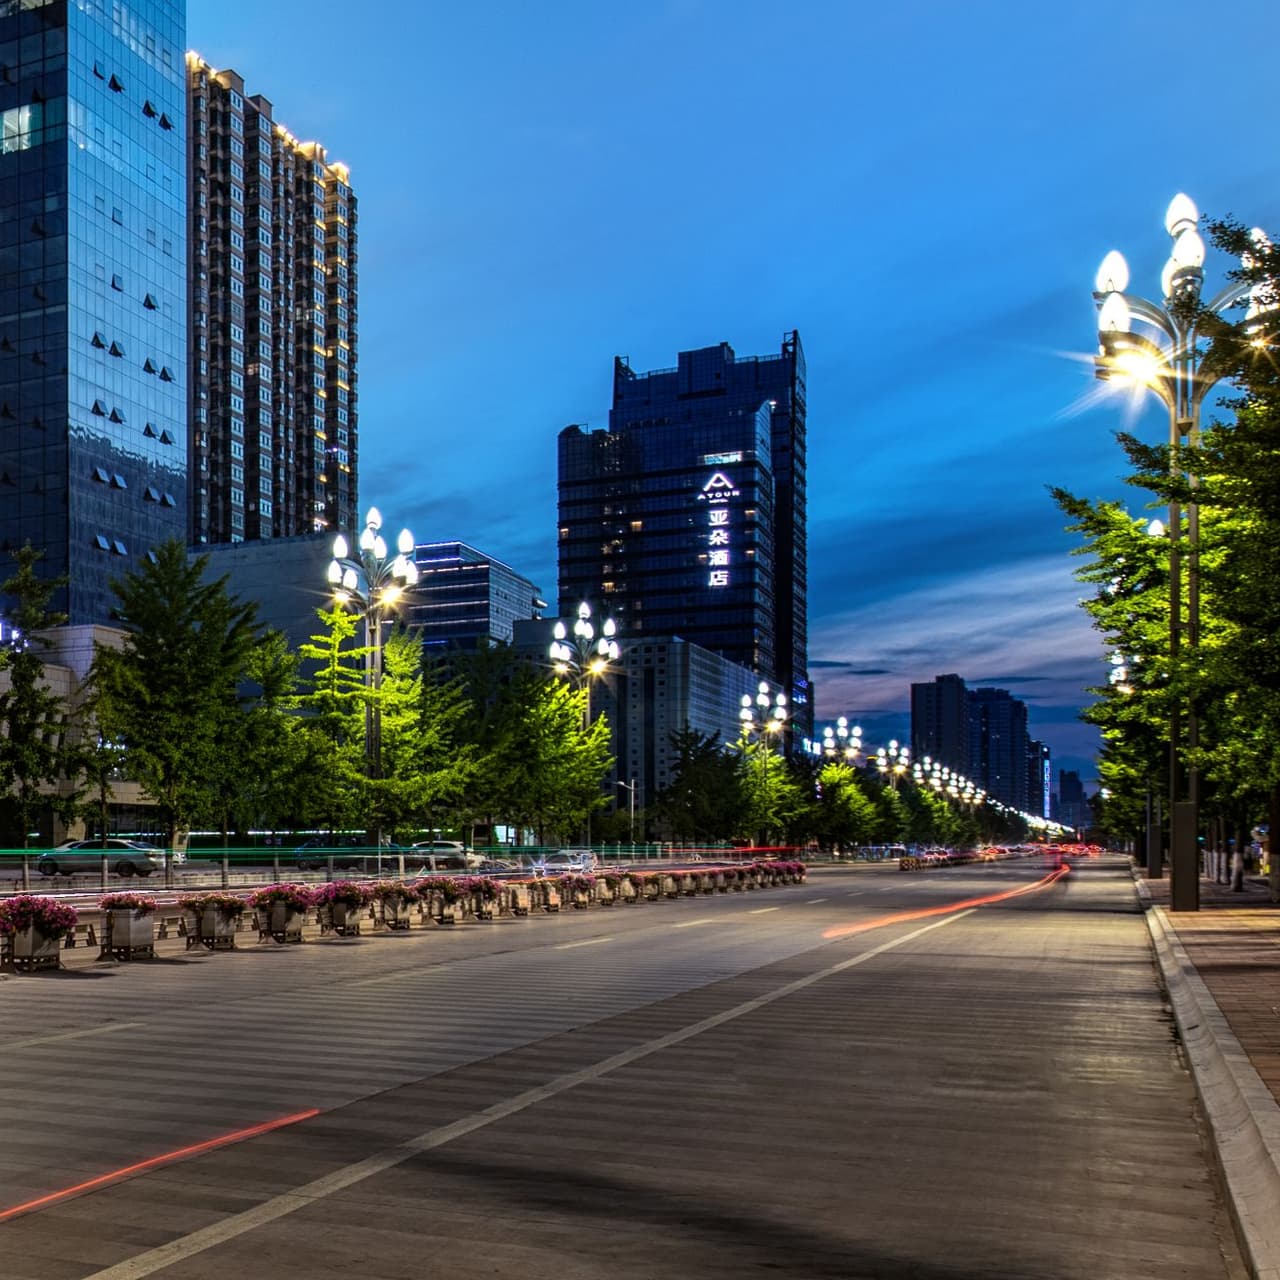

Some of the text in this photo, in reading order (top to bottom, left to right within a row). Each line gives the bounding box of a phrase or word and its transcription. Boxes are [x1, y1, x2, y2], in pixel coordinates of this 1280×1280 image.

[697, 490, 740, 500] ATOUR
[708, 509, 729, 587] 亚朵酒店
